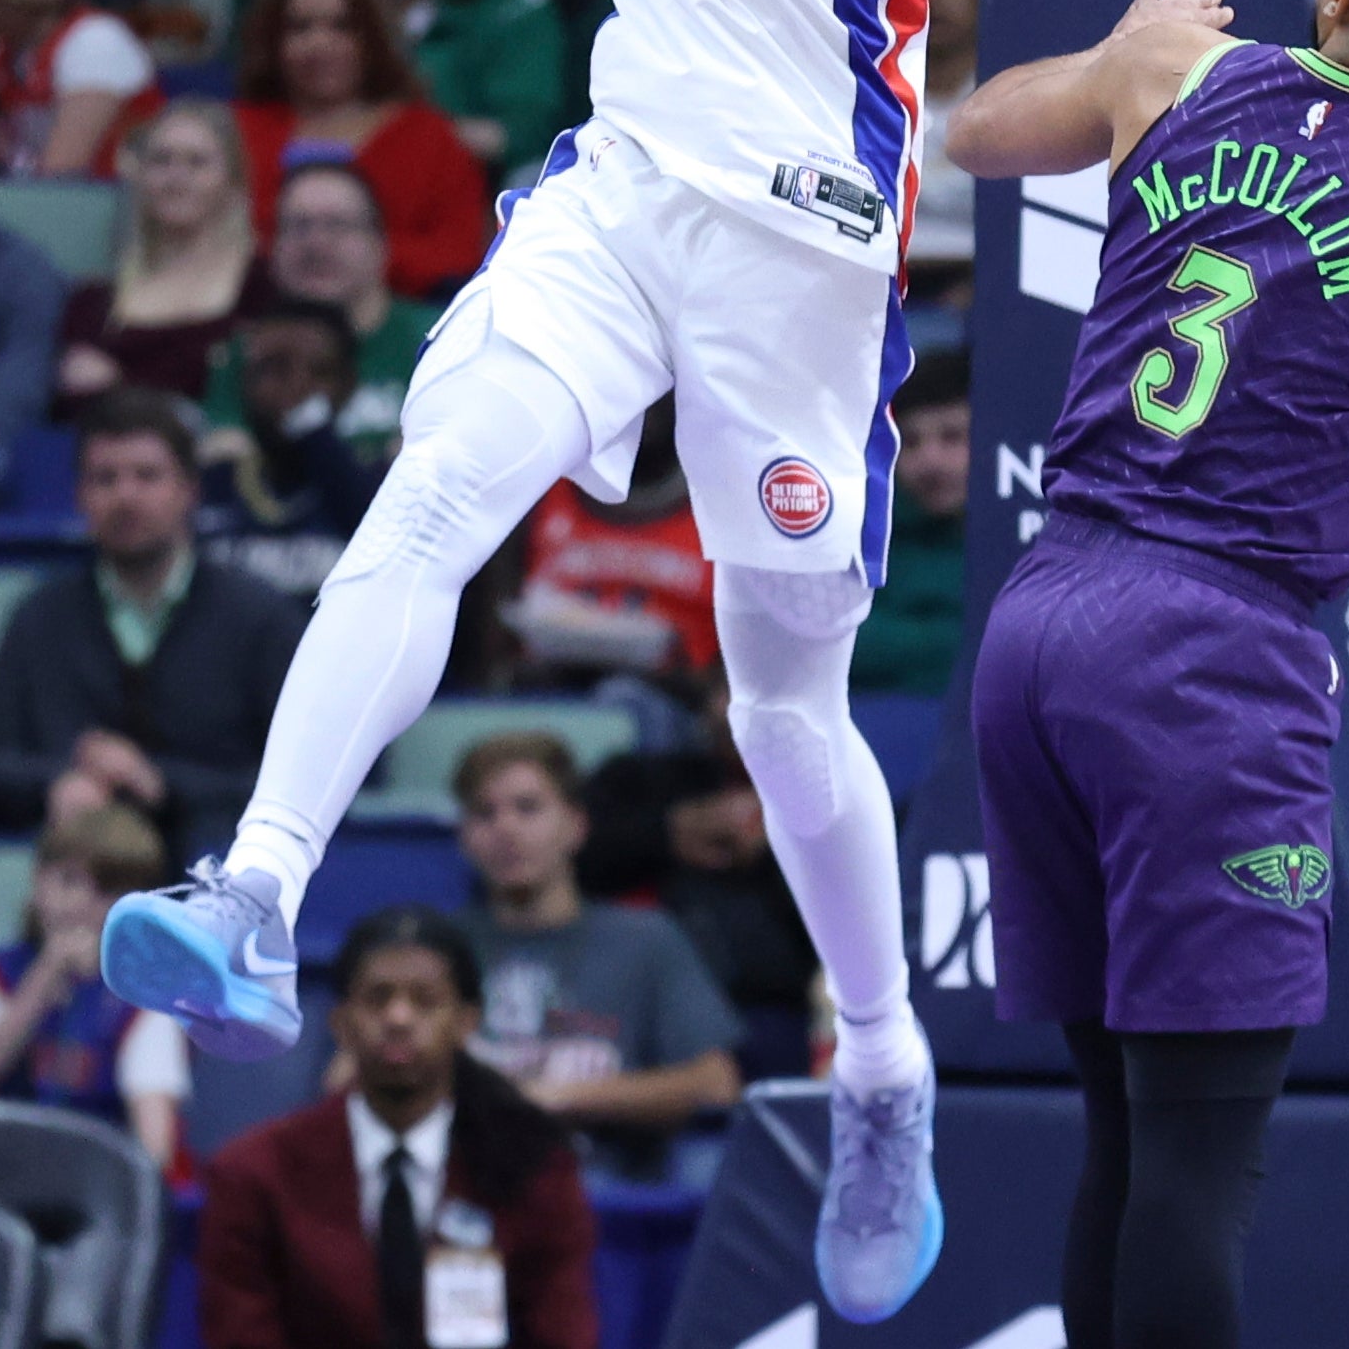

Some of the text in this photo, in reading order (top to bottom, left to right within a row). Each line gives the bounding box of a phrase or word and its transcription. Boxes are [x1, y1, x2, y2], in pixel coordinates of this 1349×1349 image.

[1130, 243, 1258, 440] 3
[771, 483, 819, 498] DETROIT
[771, 497, 820, 513] PISTONS
